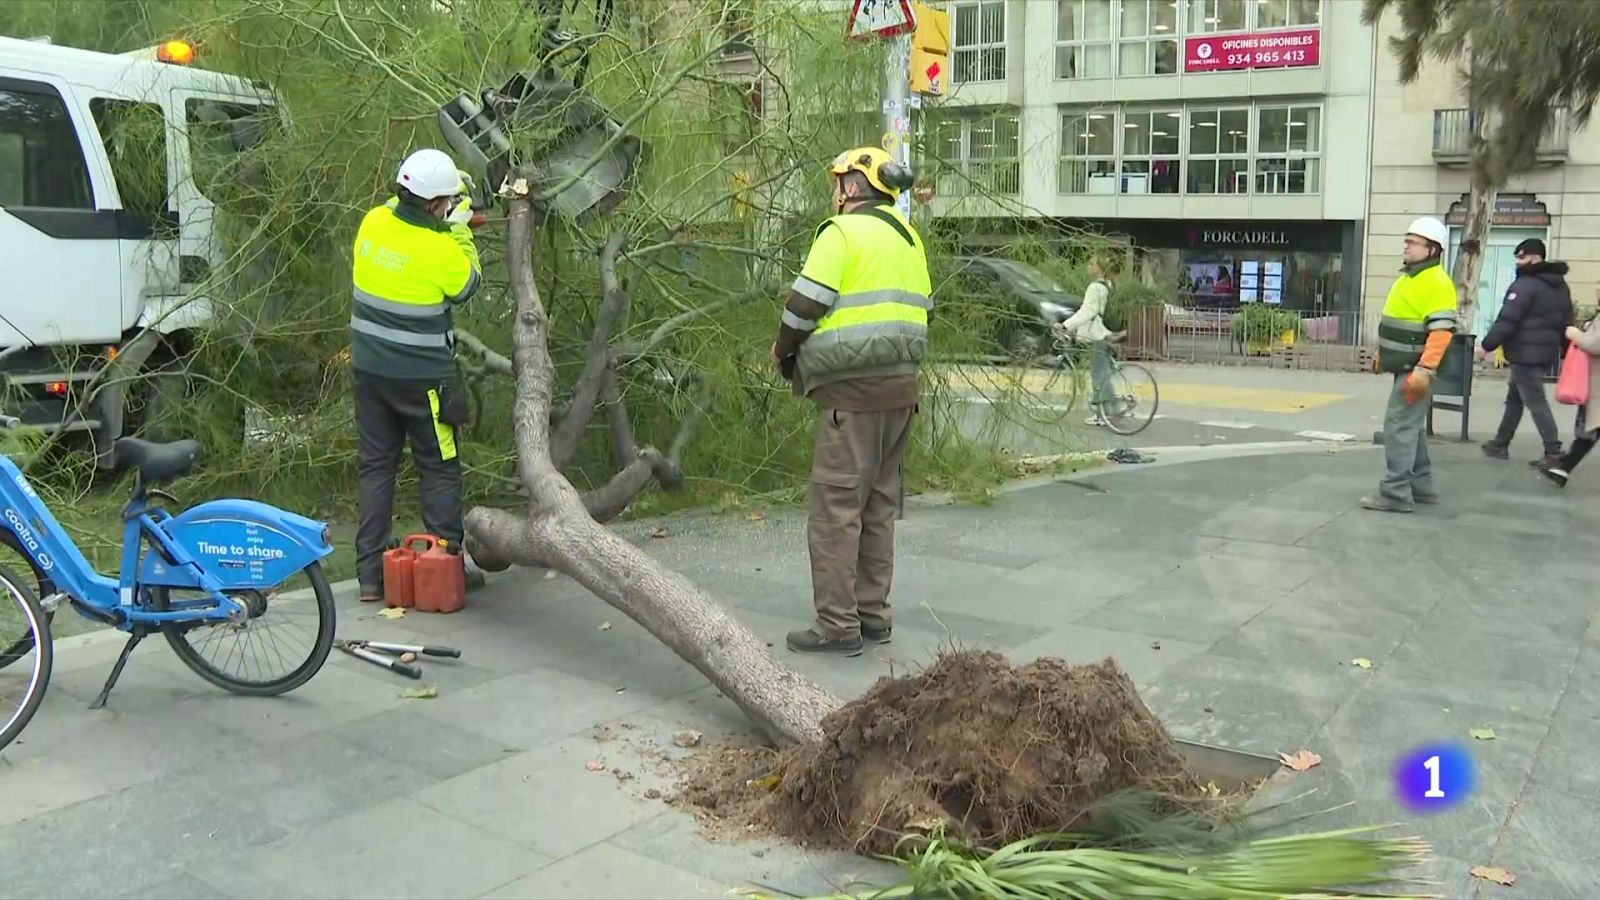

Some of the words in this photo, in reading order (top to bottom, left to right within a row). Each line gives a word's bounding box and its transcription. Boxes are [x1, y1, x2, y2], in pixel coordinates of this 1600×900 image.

[1222, 39, 1258, 50] OFICINES
[1260, 35, 1313, 48] DISPONIBLES
[1227, 53, 1250, 64] 934
[1255, 52, 1279, 63] 965
[1283, 50, 1305, 61] 413
[1203, 230, 1289, 244] FORCADELL
[4, 508, 39, 551] cooltra
[197, 541, 227, 555] Time
[230, 545, 244, 555] to
[247, 545, 287, 559] share.
